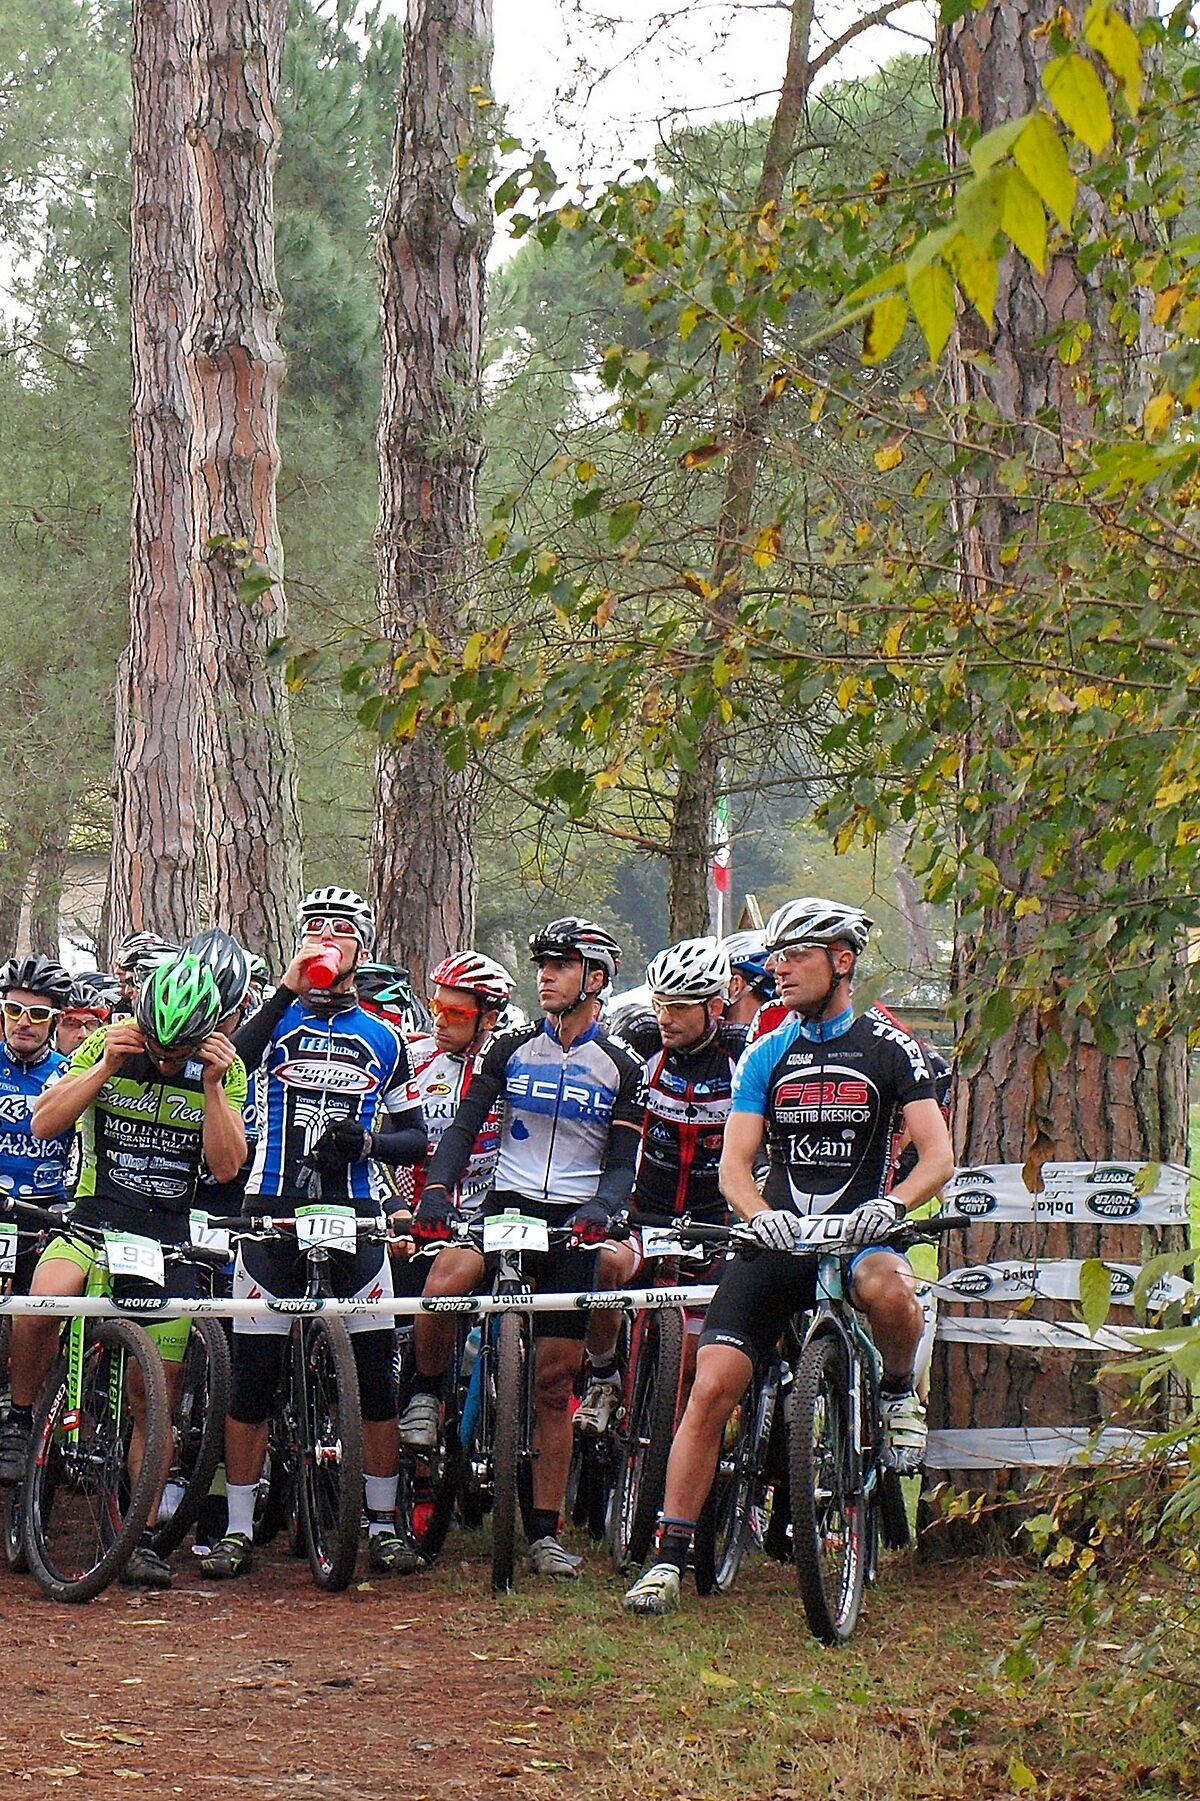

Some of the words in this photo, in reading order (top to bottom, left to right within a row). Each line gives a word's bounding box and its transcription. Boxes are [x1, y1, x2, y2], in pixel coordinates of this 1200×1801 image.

[872, 1022, 931, 1083] TREK
[774, 1081, 869, 1107] FBS
[97, 1083, 159, 1113] Sambi
[167, 1095, 206, 1123] Tea
[1094, 1194, 1134, 1205] ROVER
[1031, 1202, 1075, 1216] Dakar
[1097, 1203, 1133, 1215] LAND
[308, 1218, 346, 1236] 116
[501, 1225, 529, 1239] 71
[805, 1218, 845, 1240] 70
[123, 1245, 156, 1268] 93
[1003, 1265, 1042, 1281] Dakar
[123, 1298, 163, 1309] ROVER
[279, 1301, 318, 1312] ROVER
[434, 1302, 472, 1312] ROVER
[587, 1300, 626, 1310] ROVER
